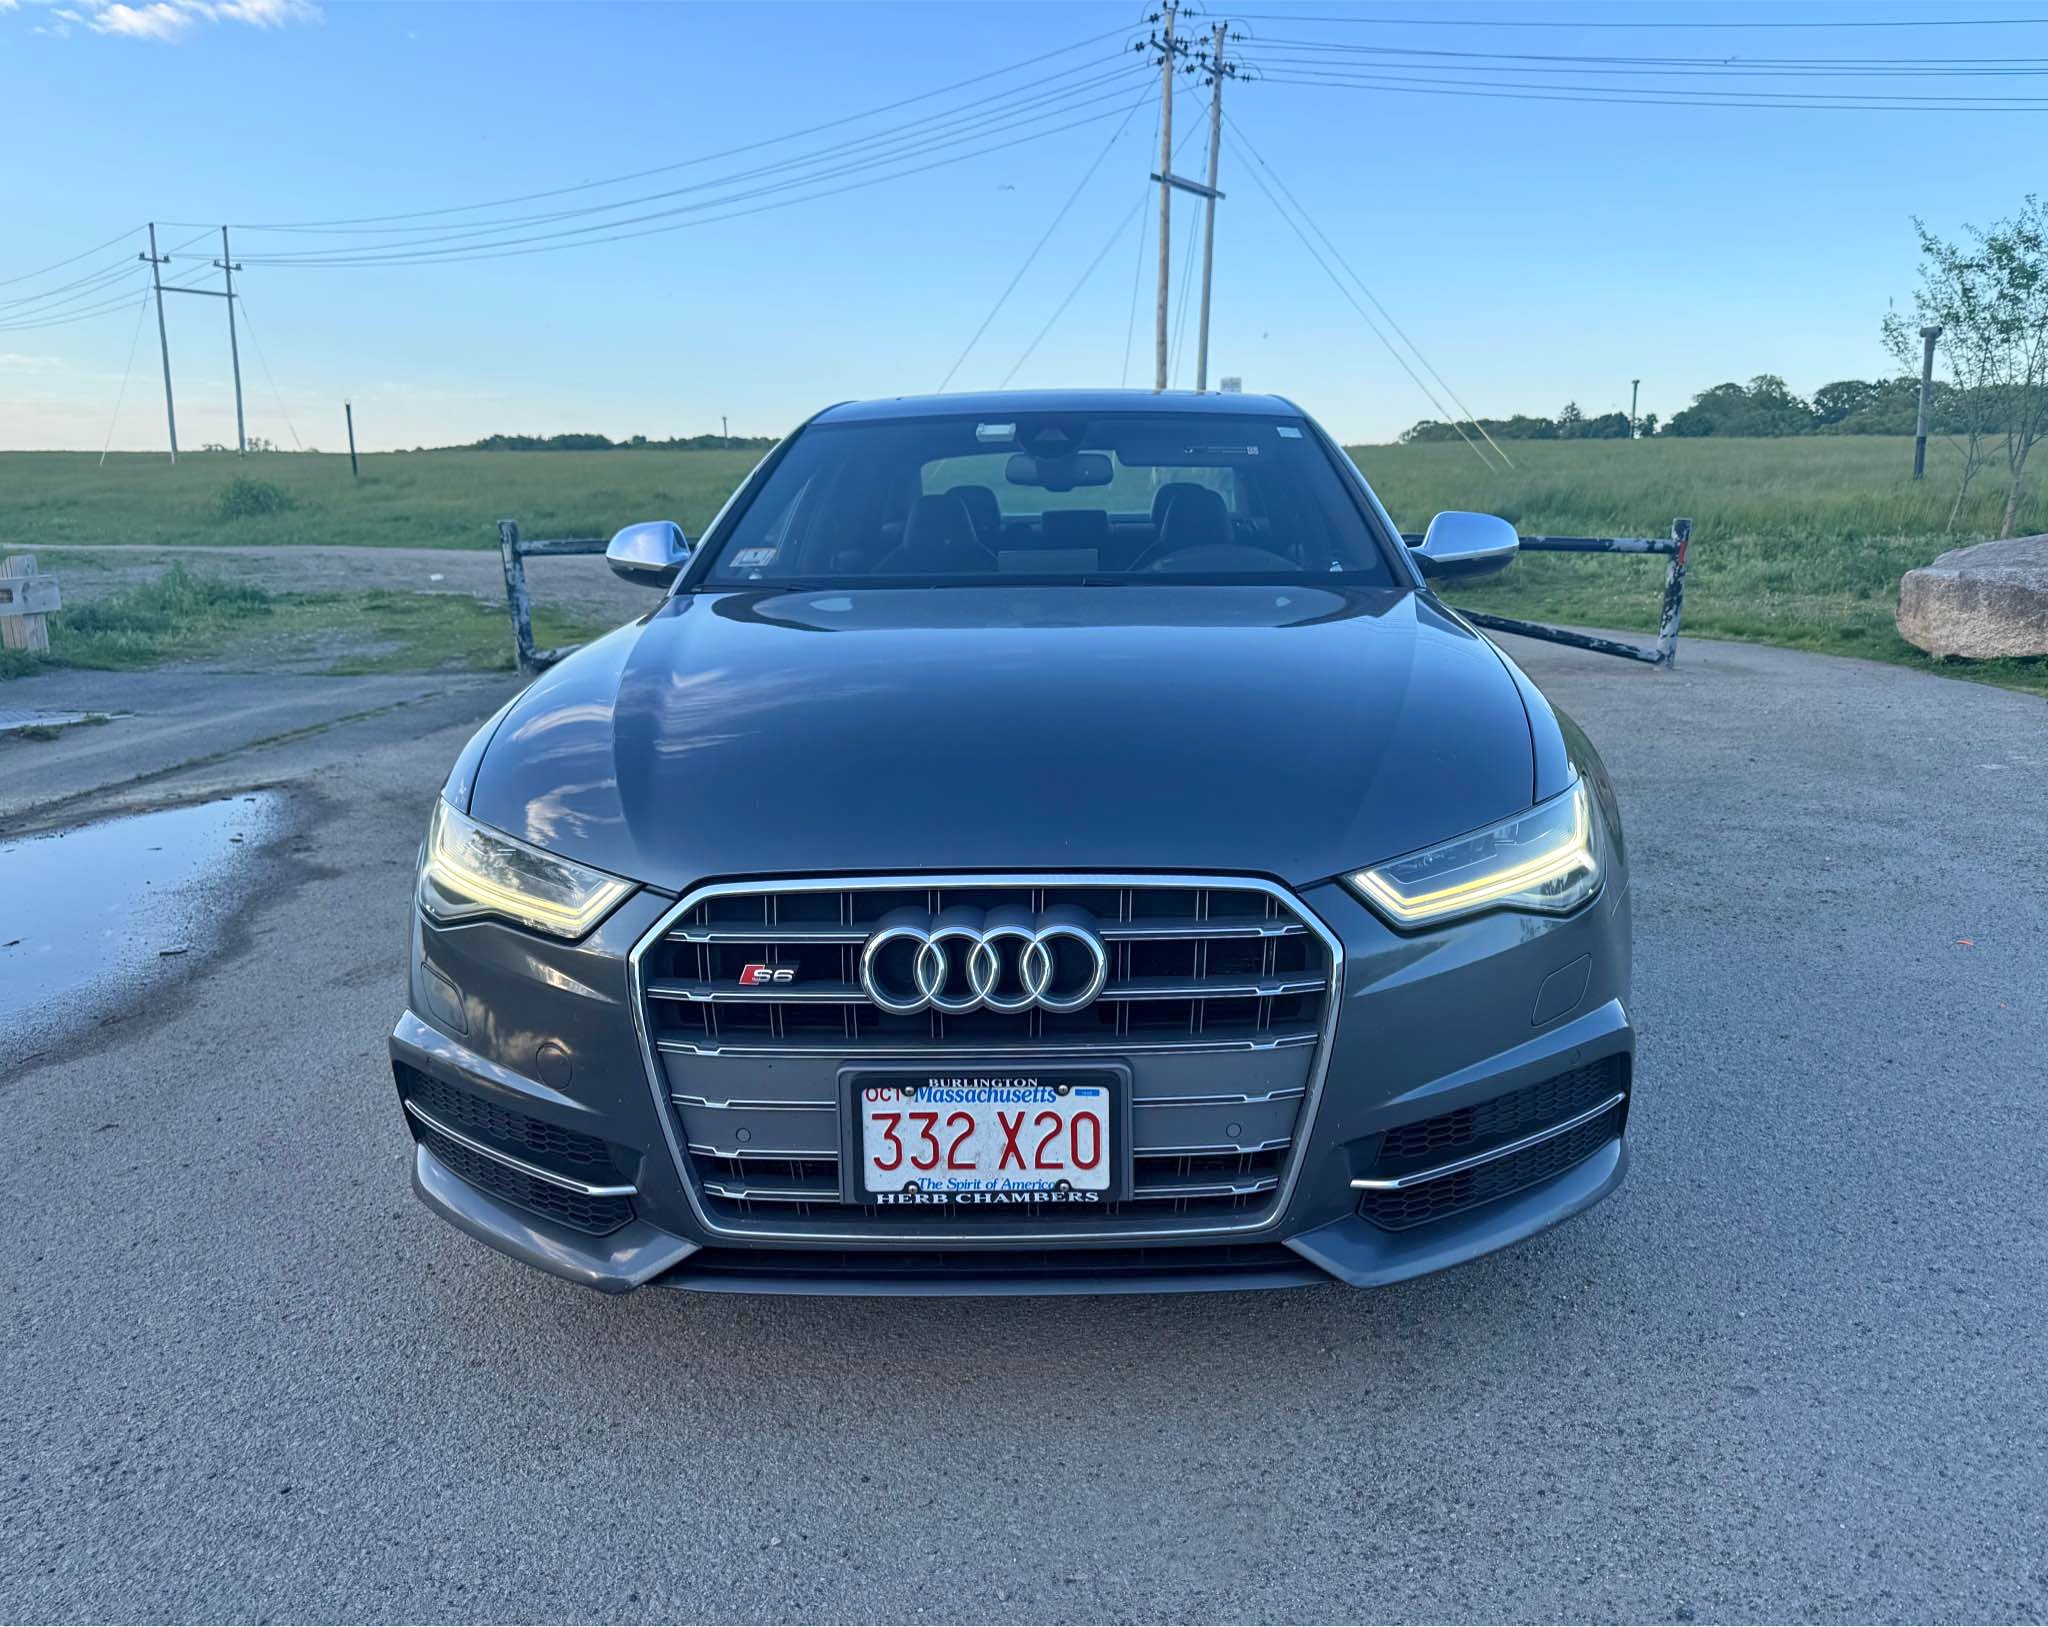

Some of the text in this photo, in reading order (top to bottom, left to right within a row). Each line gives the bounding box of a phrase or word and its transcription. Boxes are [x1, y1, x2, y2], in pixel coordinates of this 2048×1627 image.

[753, 969, 794, 983] S6
[928, 1078, 1038, 1088] BURLINGTON
[915, 1087, 1057, 1103] Massachusetts
[871, 1111, 1101, 1171] 332 X20
[918, 1178, 943, 1190] The
[948, 1179, 981, 1192] Spirit
[986, 1178, 999, 1192] of
[876, 1192, 1100, 1205] HERB CHAMBERS
